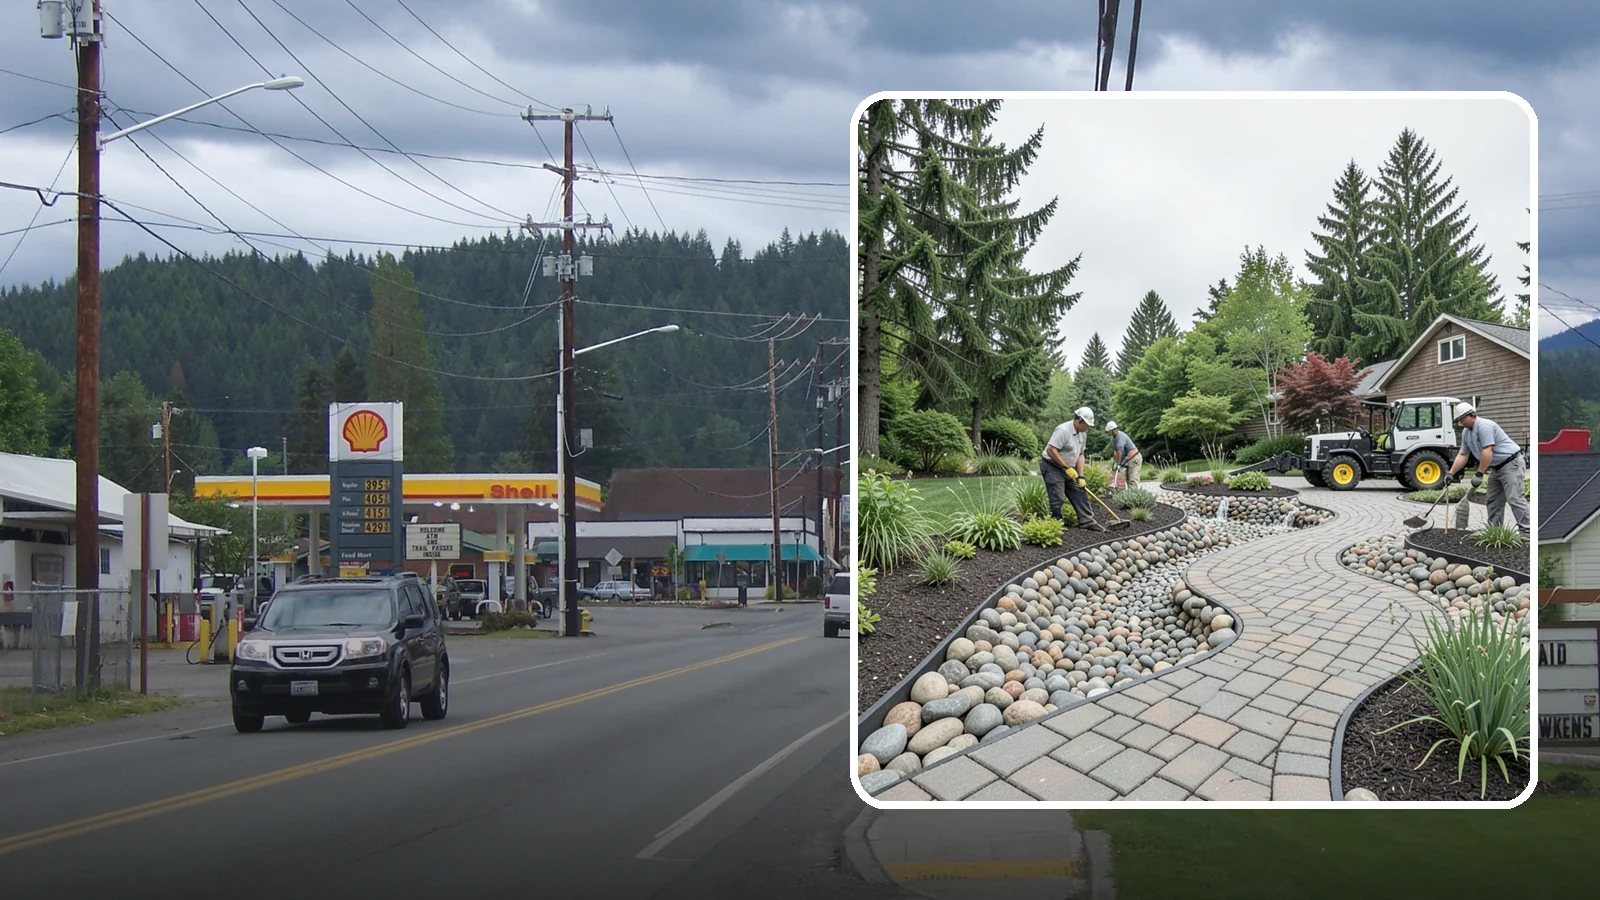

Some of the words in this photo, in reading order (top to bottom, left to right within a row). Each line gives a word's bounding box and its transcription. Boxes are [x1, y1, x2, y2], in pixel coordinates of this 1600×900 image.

[366, 481, 383, 490] 395
[490, 484, 547, 499] Shell
[366, 494, 383, 504] 405
[366, 508, 383, 518] 415
[366, 522, 383, 532] 429
[1538, 643, 1567, 665] AID
